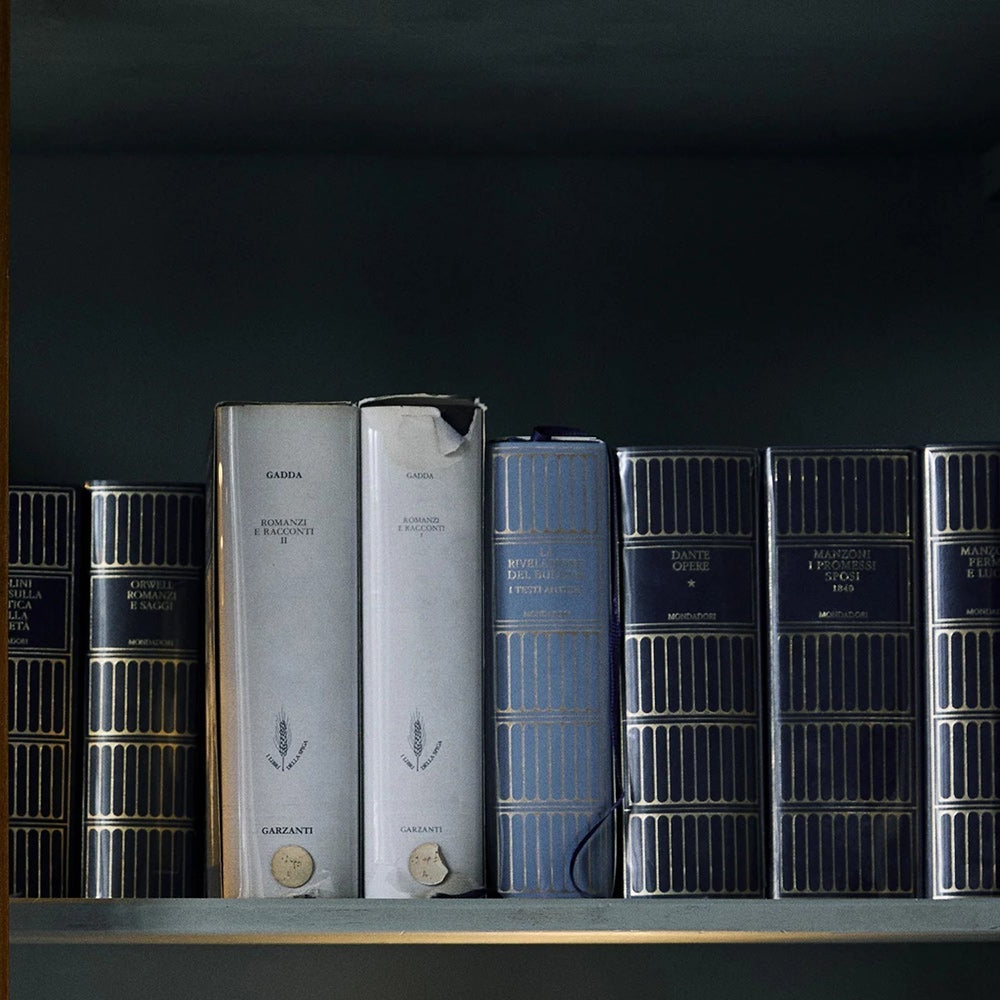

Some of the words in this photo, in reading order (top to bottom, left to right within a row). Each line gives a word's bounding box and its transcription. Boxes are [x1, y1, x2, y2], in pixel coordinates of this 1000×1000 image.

[265, 471, 303, 480] GADDA
[406, 472, 434, 480] GADDA
[260, 518, 308, 526] ROMANZI
[402, 516, 440, 524] ROMANZI
[254, 528, 261, 536] E
[263, 528, 315, 536] RACCONTI
[280, 536, 288, 544] II
[671, 550, 711, 560] DANTE
[812, 549, 872, 559] MANZONI
[672, 561, 711, 571] OPERE
[808, 560, 814, 570] I
[816, 560, 878, 571] PROMESSI
[825, 571, 860, 581] SPOSI
[967, 568, 976, 578] E
[8, 578, 33, 588] LINI
[130, 580, 174, 590] ORWELL
[832, 583, 855, 593] 1840
[127, 590, 177, 601] ROMANZI
[130, 601, 138, 610] E
[140, 601, 175, 611] SAGGI
[667, 612, 717, 621] MONDADORI
[818, 610, 869, 618] MONDADORI
[261, 826, 314, 835] GARZANTI
[400, 826, 443, 834] GARZANTI
